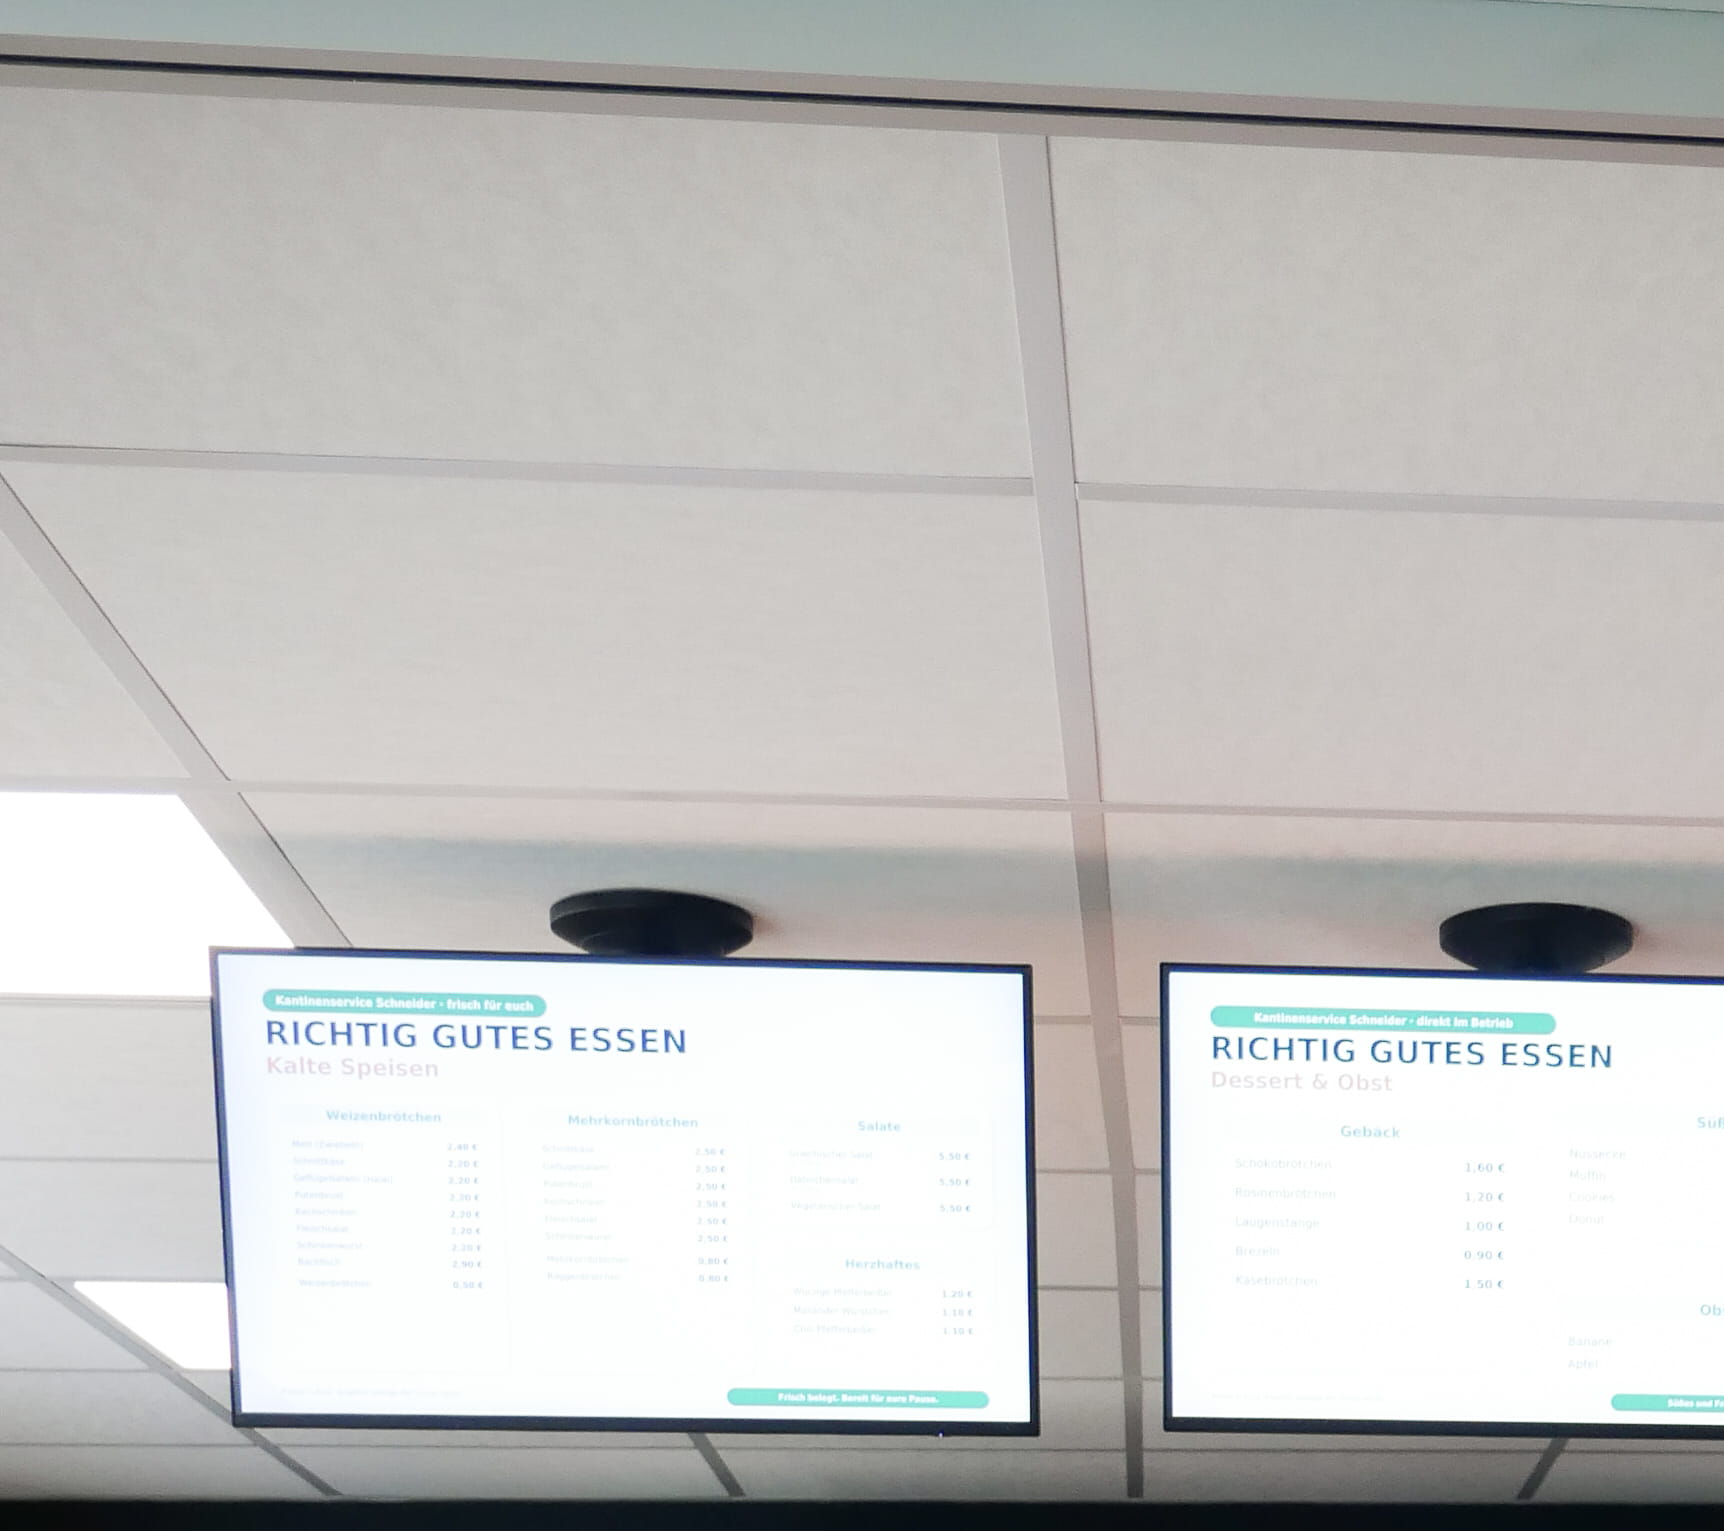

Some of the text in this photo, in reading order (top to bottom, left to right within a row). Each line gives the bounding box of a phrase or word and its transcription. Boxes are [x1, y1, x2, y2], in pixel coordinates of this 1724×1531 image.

[276, 995, 534, 1012] Kantinenservice Schneider frisch für euch
[1254, 1011, 1347, 1026] Kantinenservice
[1349, 1013, 1407, 1027] Schneider
[1416, 1015, 1451, 1028] direkt
[1472, 1017, 1513, 1029] Betrieb
[266, 1020, 688, 1054] RICHTIG GUTES ESSEN
[1212, 1036, 1612, 1068] RICHTIG GUTES ESSEN
[266, 1057, 439, 1079] Kalte Speisen
[1211, 1071, 1393, 1091] Dessert & Obst
[326, 1110, 442, 1123] Weizenbrötchen
[568, 1115, 699, 1128] Mehrkornbrötchen
[857, 1120, 901, 1132] Salate
[1340, 1124, 1400, 1138] Gebäck
[1464, 1162, 1494, 1174] 1,60
[1464, 1192, 1494, 1203] 1,20
[1464, 1221, 1494, 1232] 1,00
[1464, 1250, 1494, 1261] 0,90
[845, 1259, 921, 1270] Herzhaftes
[1464, 1279, 1494, 1290] 1,50
